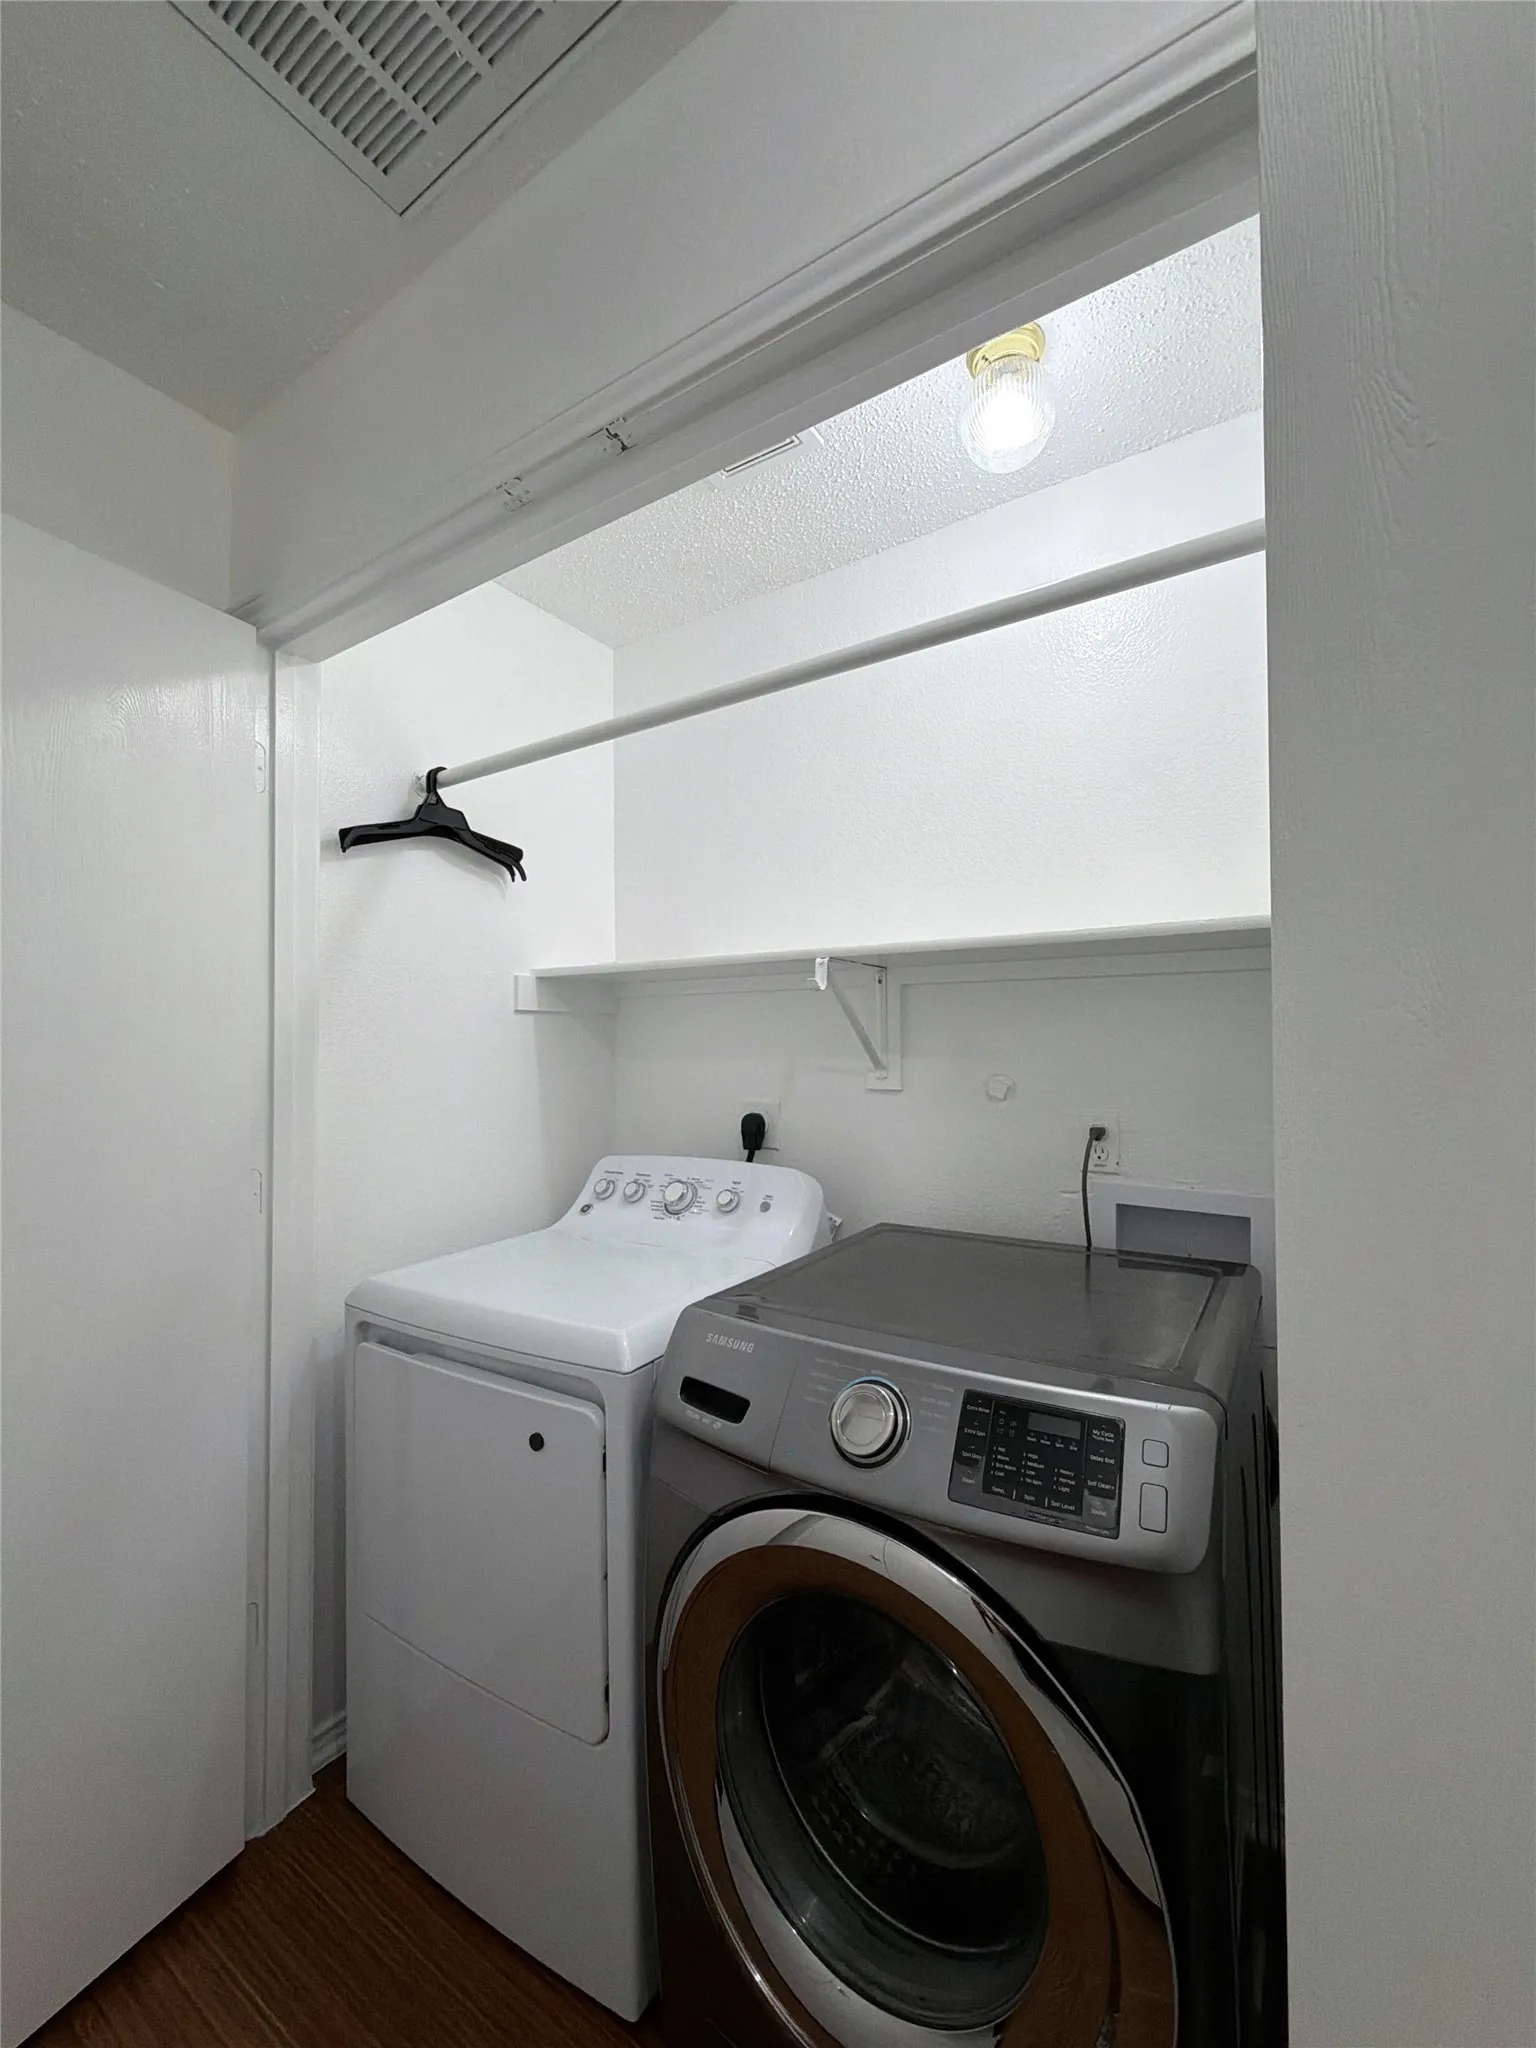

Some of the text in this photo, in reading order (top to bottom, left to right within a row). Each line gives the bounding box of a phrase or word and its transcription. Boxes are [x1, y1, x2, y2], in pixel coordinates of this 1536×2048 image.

[706, 1332, 755, 1353] SAMSUNG
[1101, 1430, 1114, 1438] Cycle
[1061, 1502, 1076, 1511] Level
